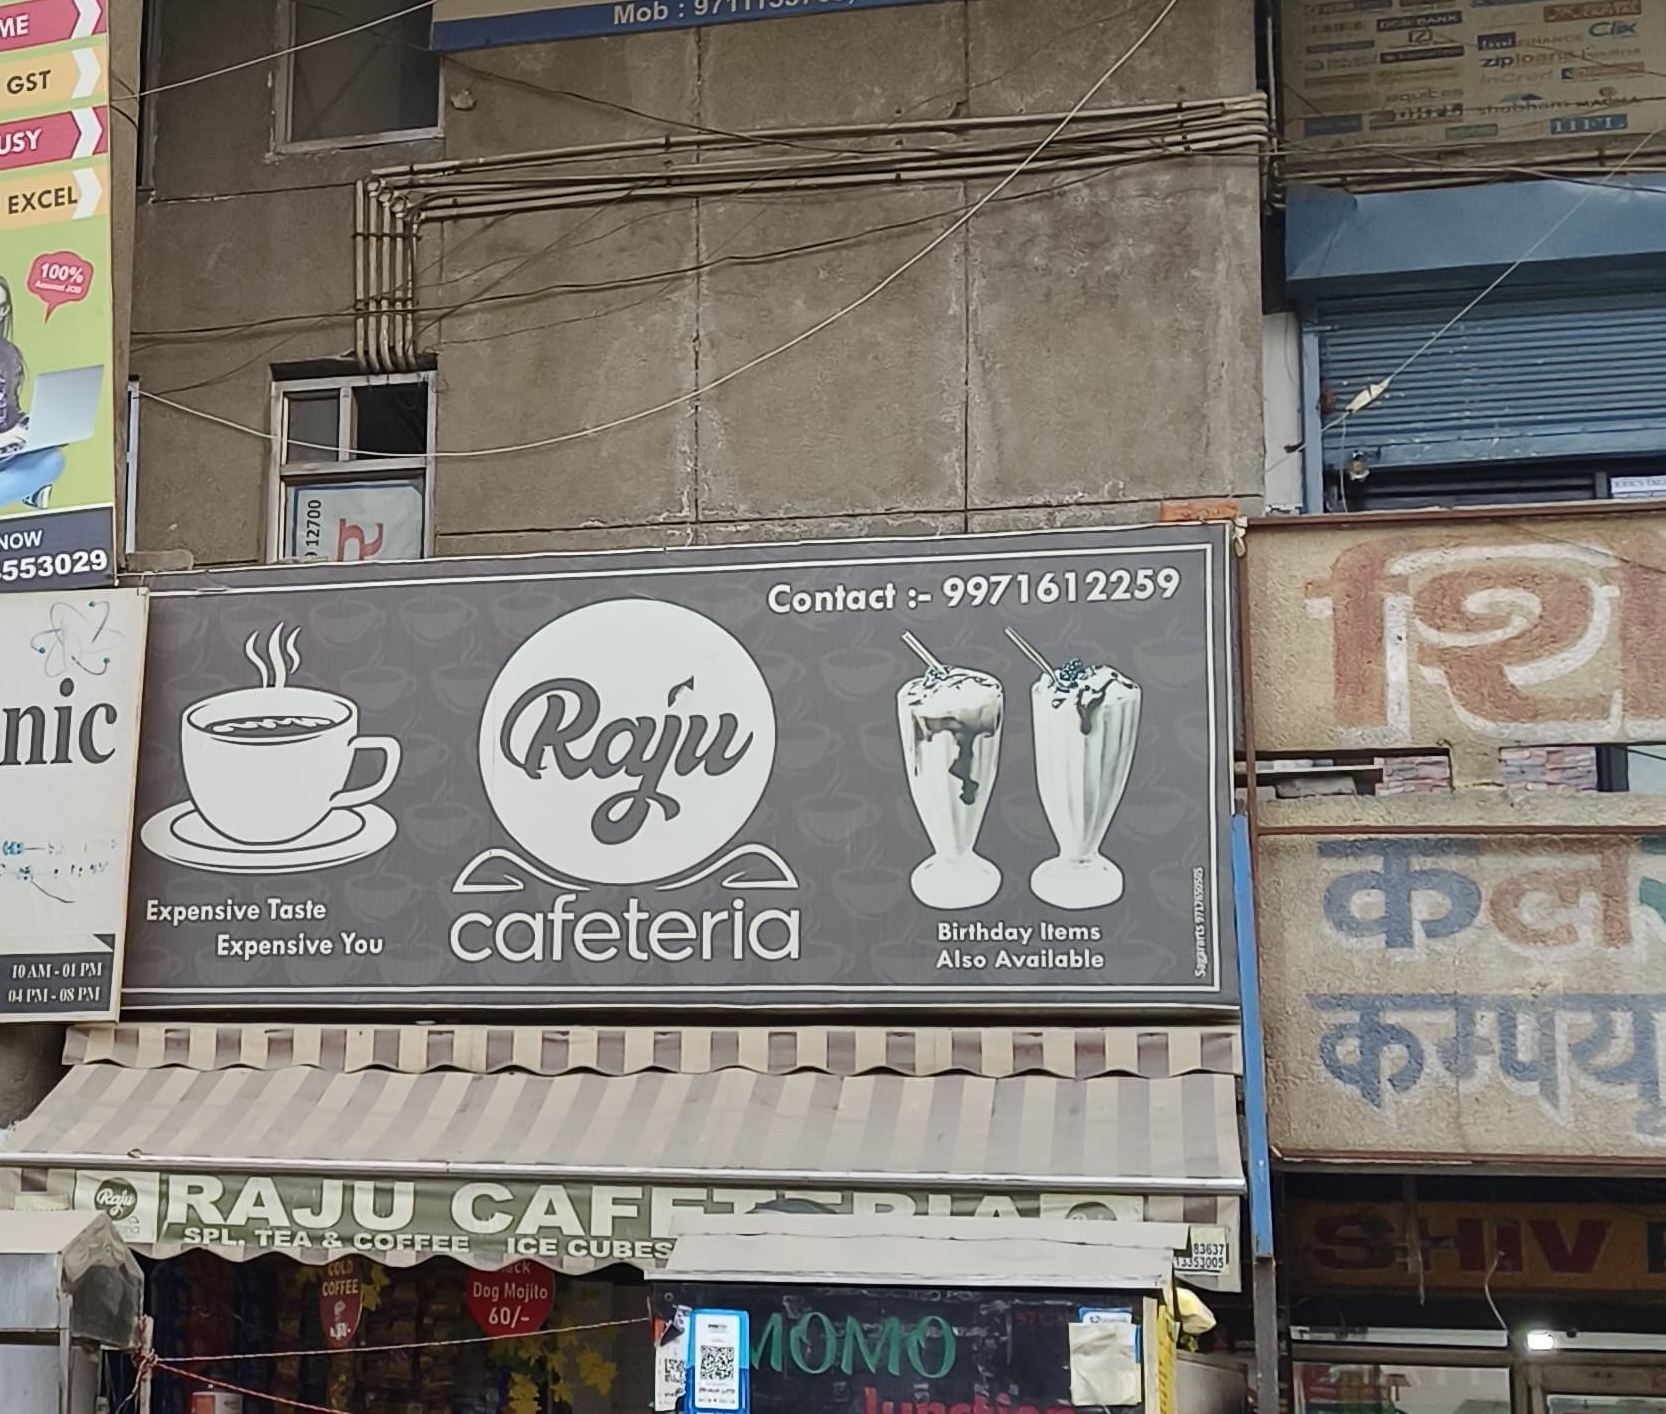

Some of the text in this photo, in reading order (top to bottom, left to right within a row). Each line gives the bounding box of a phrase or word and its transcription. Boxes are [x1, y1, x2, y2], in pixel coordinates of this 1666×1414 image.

[767, 567, 1181, 615] Contact 9971612259
[501, 673, 755, 845] Raju
[146, 898, 327, 924] Expensive Taste
[451, 898, 801, 962] cafeteria
[936, 919, 1102, 946] Birthday Items
[168, 1175, 415, 1230] RAJU
[184, 1227, 676, 1259] SPL. TEA & COFFEE ICE CUBES
[473, 1281, 548, 1303] Dog Mojito
[489, 1306, 530, 1328] 60/-
